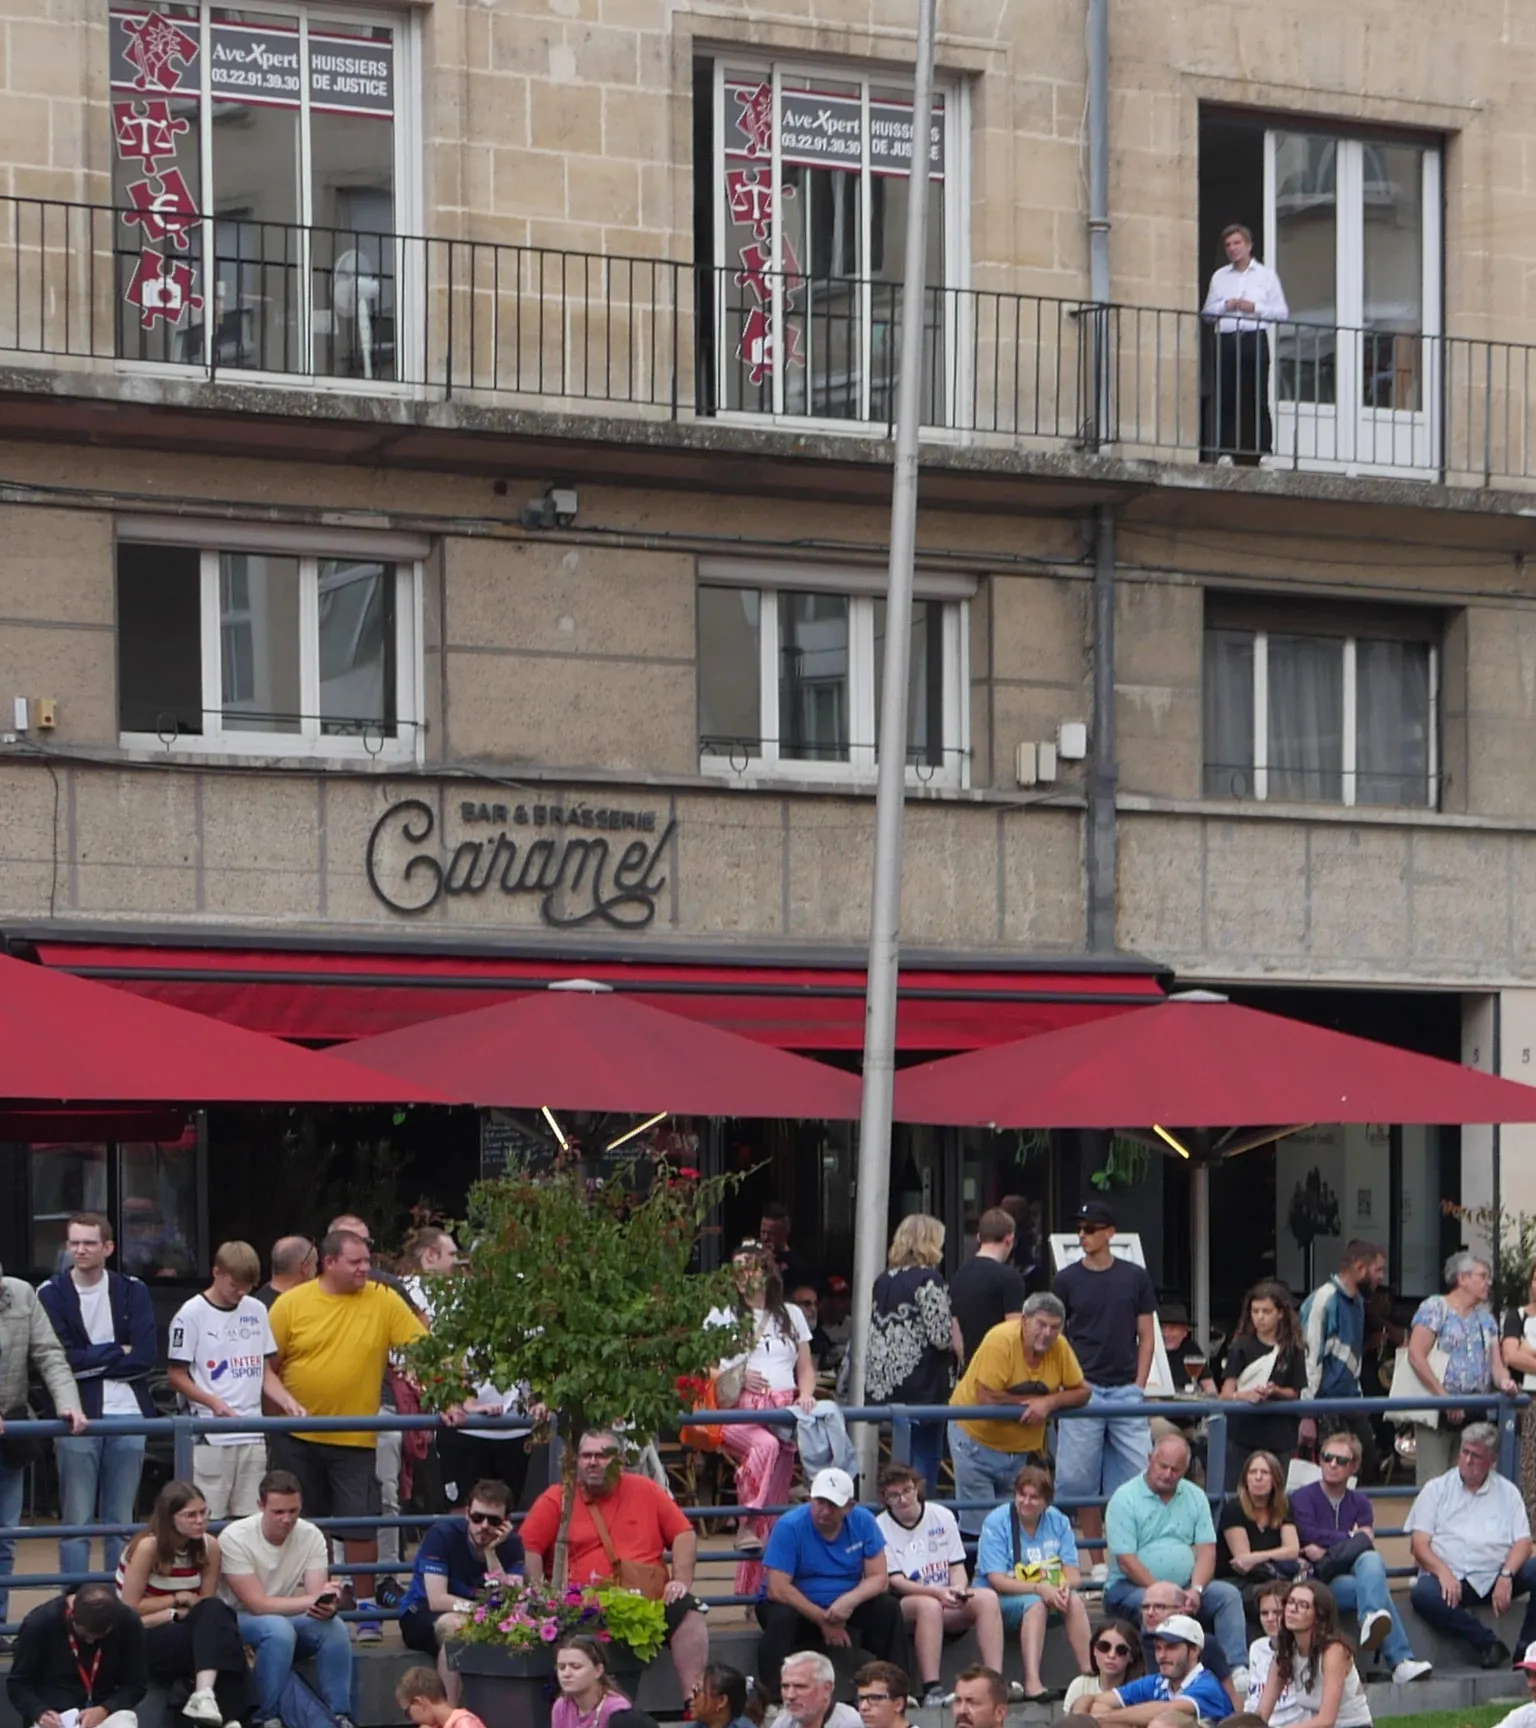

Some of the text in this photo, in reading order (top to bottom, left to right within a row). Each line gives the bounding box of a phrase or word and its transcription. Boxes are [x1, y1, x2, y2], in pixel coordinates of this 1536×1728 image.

[212, 42, 298, 70] AveXpert
[311, 54, 388, 77] HUISSIERS
[211, 68, 300, 91] 03.22.91.39.30
[312, 73, 388, 97] DE JUSTICE
[782, 109, 860, 135] AveXpert
[871, 119, 940, 143] HUISSIS
[871, 140, 940, 161] DE JUSE
[461, 801, 656, 833] BAR & BRASSERIE
[366, 798, 677, 930] Caramel
